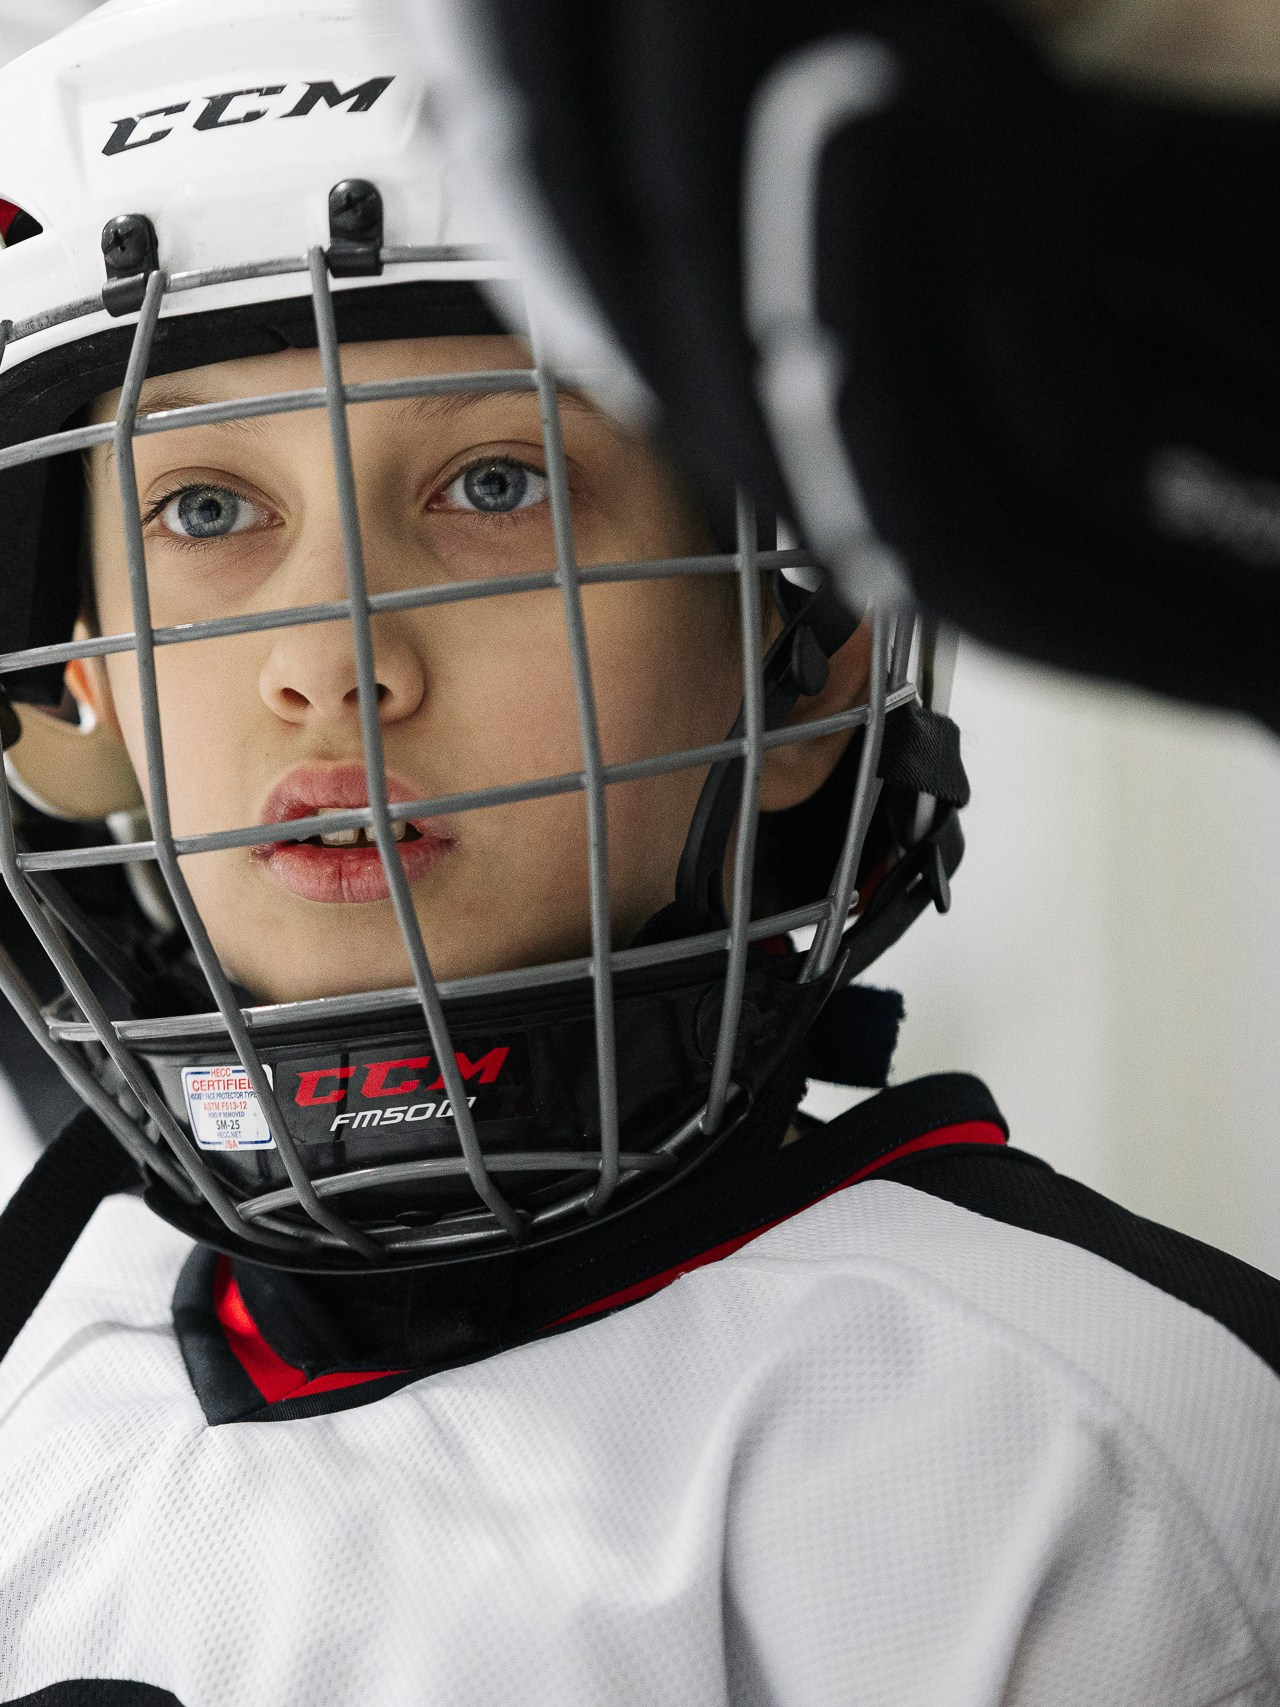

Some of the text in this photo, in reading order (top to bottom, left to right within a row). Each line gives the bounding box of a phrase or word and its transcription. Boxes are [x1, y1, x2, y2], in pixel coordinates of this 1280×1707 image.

[101, 75, 397, 157] CCM
[210, 1067, 231, 1077] HECC
[295, 1047, 510, 1107] CCM
[215, 1119, 240, 1130] SM-25
